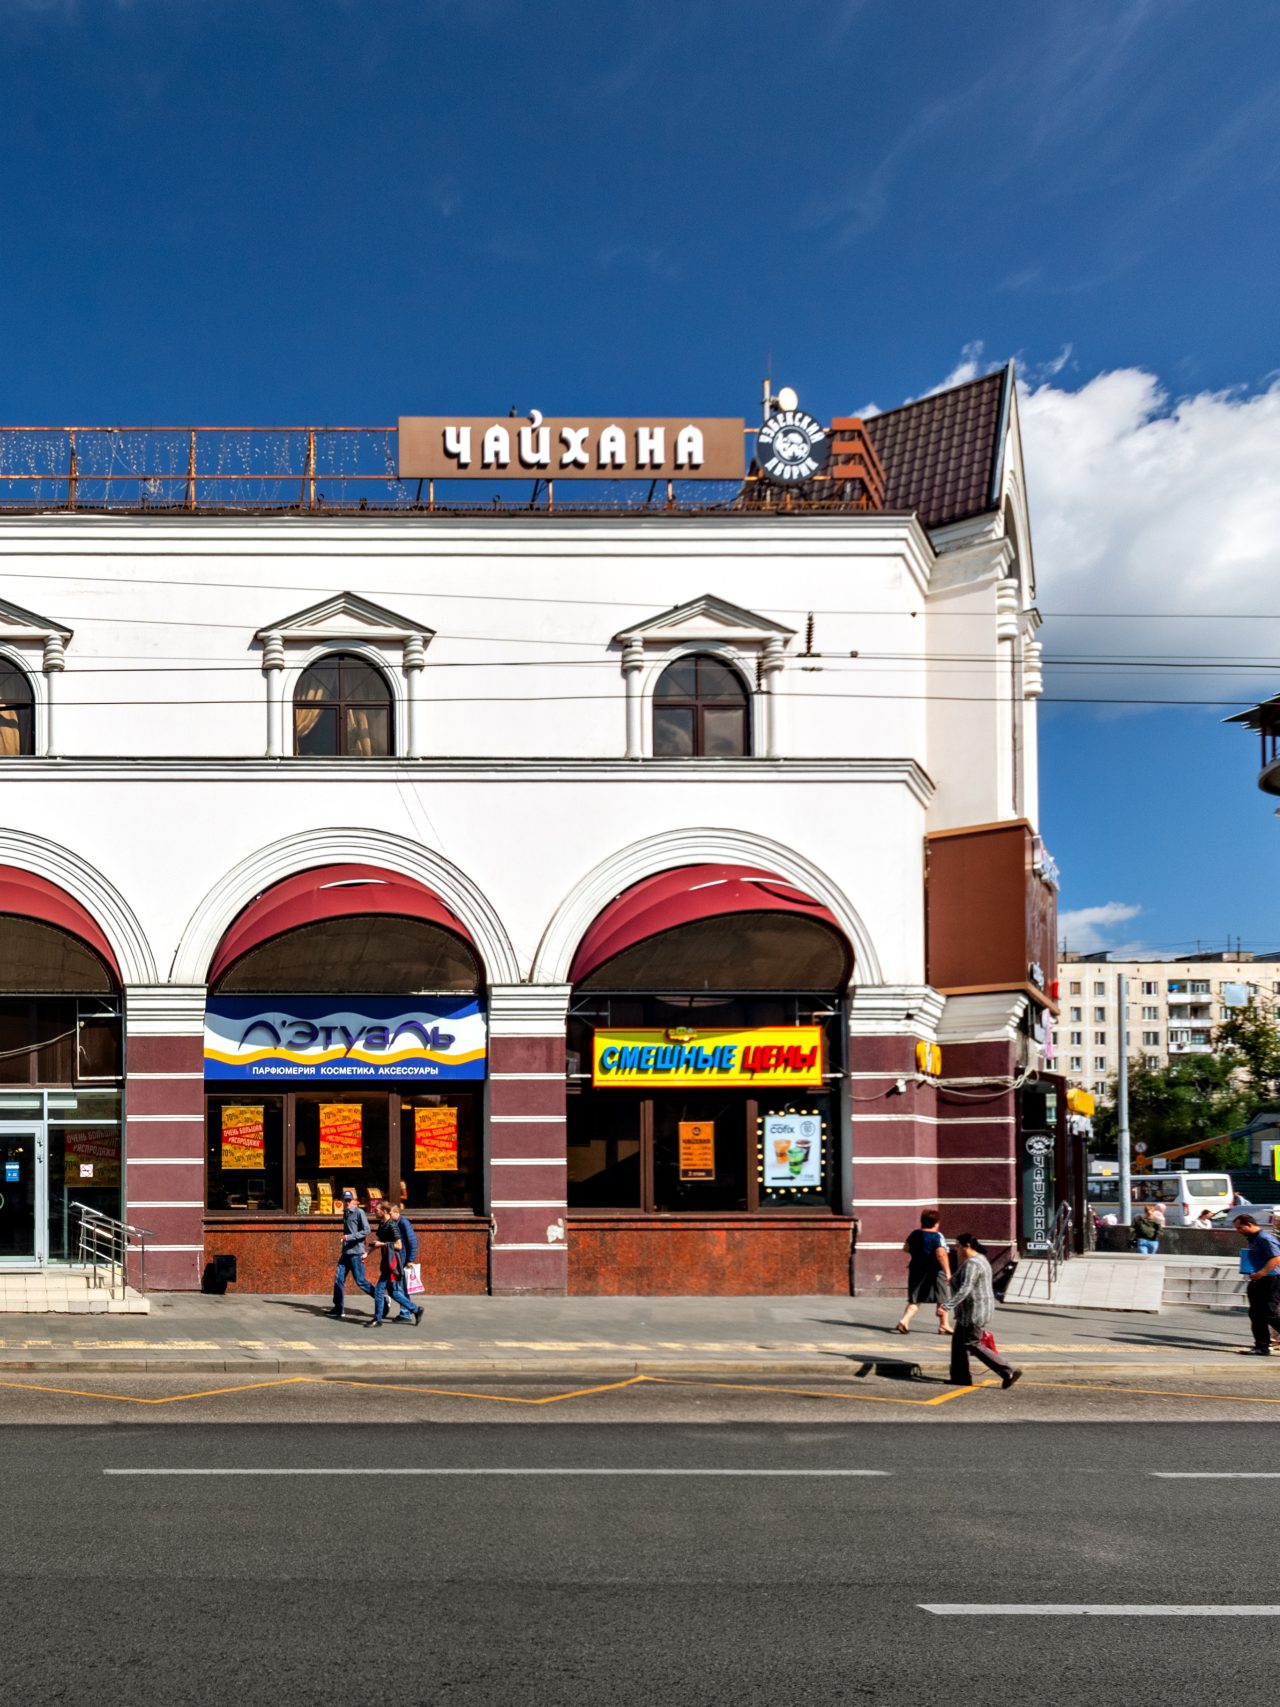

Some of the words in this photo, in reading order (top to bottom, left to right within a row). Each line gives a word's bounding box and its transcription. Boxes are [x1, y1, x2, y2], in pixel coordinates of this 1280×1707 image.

[444, 409, 705, 467] ЧАЙХАНА
[764, 457, 819, 480] ДВОРИК
[252, 1066, 316, 1076] ПАРФЮМЕРИЯ
[320, 1066, 376, 1076] КОСМЕТИКА
[377, 1066, 439, 1076] АКСЕССУАРЫ
[600, 1045, 738, 1073] СМЕШНЫЕ
[741, 1045, 819, 1076] ЦЕНЫ
[769, 1124, 796, 1135] cofix
